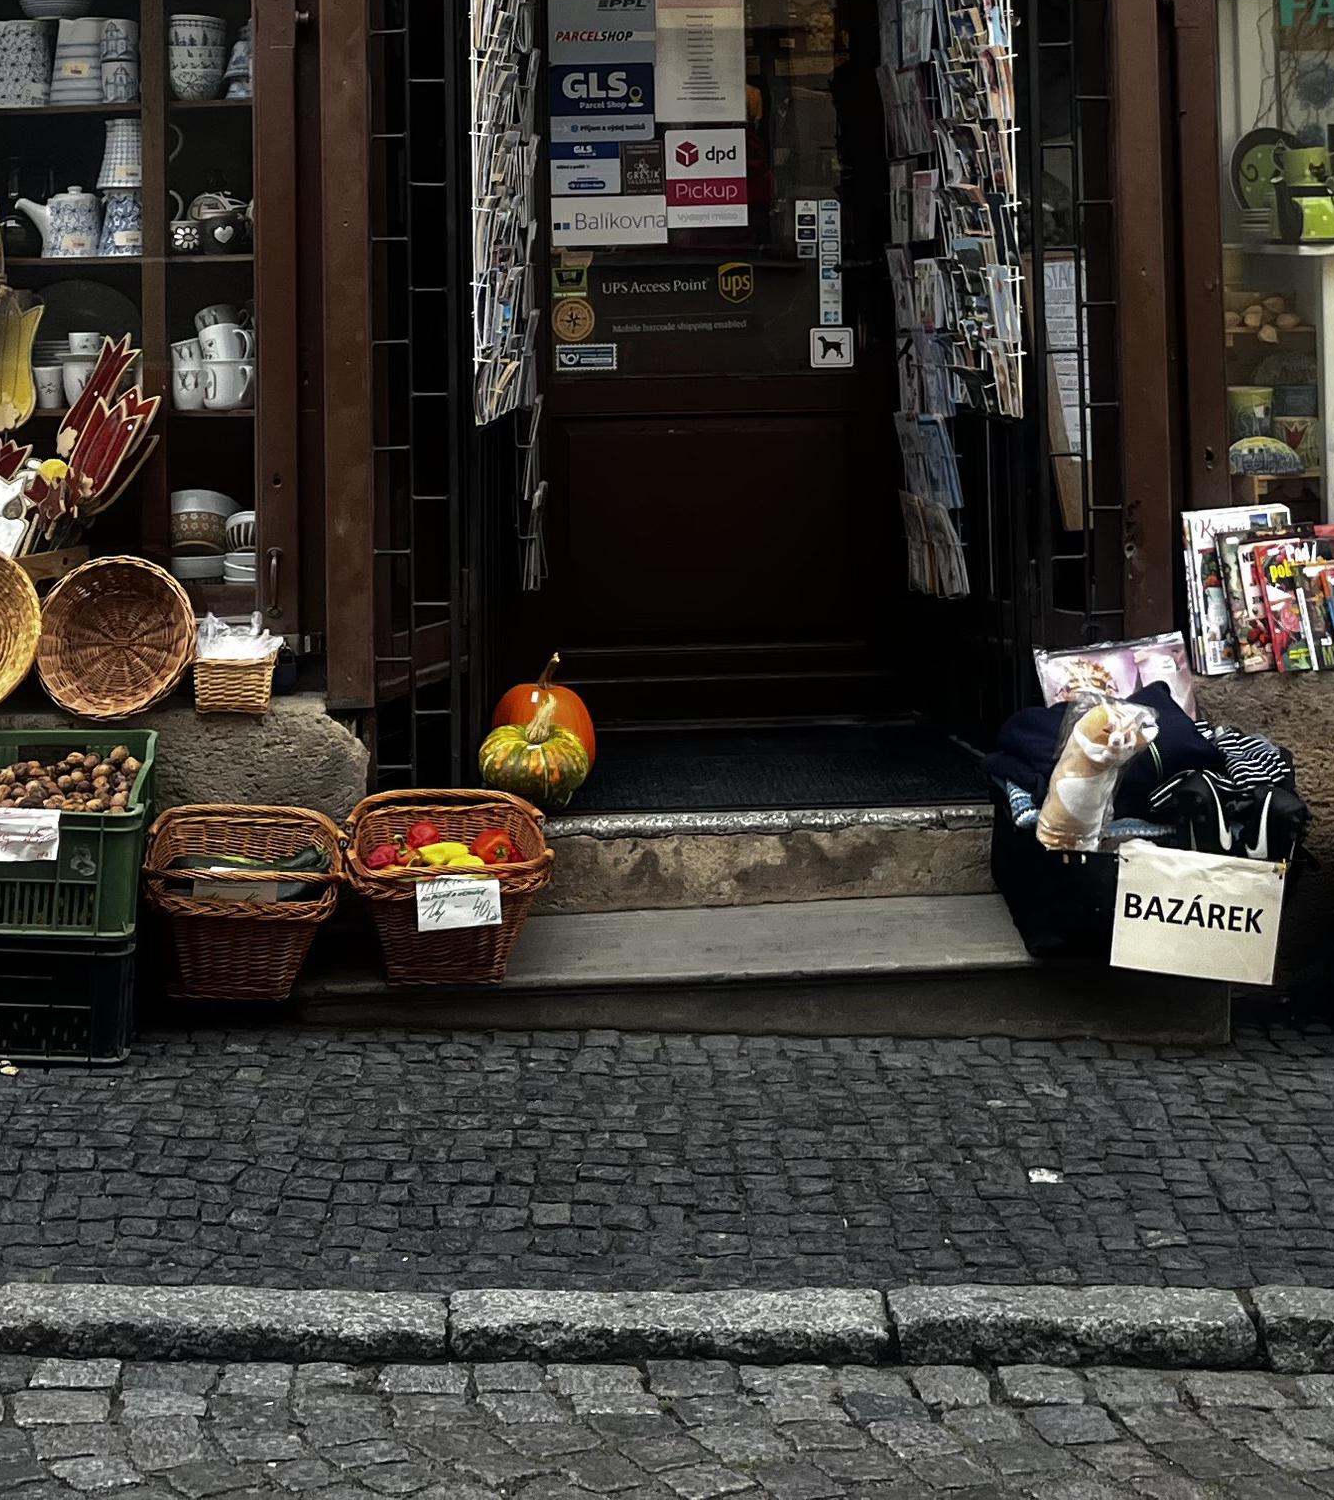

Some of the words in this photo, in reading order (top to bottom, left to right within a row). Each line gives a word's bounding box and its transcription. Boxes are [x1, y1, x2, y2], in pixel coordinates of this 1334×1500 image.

[609, 0, 647, 8] PPL
[555, 30, 633, 42] PARCELSHOP
[561, 71, 629, 99] GLS
[579, 101, 605, 109] Parcel
[606, 101, 627, 111] Shop
[573, 145, 593, 154] GLS
[705, 145, 736, 164] dpd
[676, 182, 738, 201] Pickup
[575, 211, 666, 230] Balíkovna
[602, 281, 629, 295] UPS
[630, 280, 671, 293] Access
[673, 278, 708, 292] Point
[721, 274, 751, 297] ups
[714, 319, 747, 329] enabled
[1123, 892, 1265, 935] BAZÁREK
